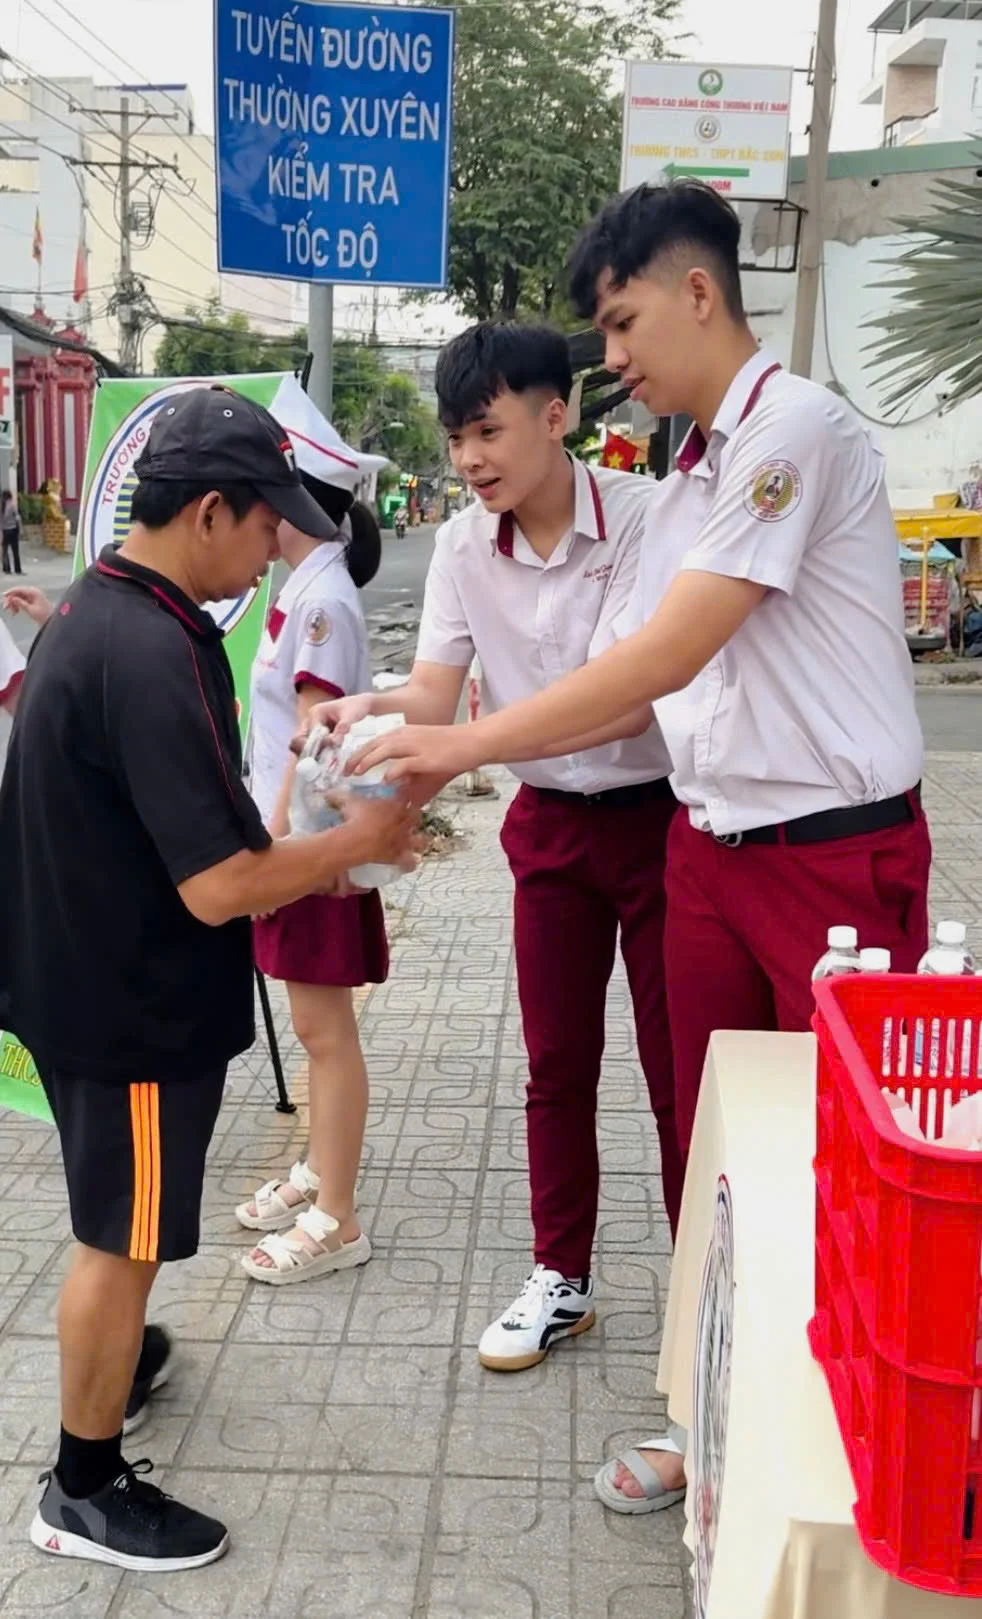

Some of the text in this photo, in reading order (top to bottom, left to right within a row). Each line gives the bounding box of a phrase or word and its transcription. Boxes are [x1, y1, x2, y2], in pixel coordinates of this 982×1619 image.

[231, 6, 432, 74] TUYẾN ĐƯỜNG
[224, 74, 440, 141] THƯỜNG XUYÊN
[268, 142, 399, 206] KIỂM TRA
[281, 210, 378, 278] TỐC ĐỘ
[0, 1041, 41, 1087] THC
